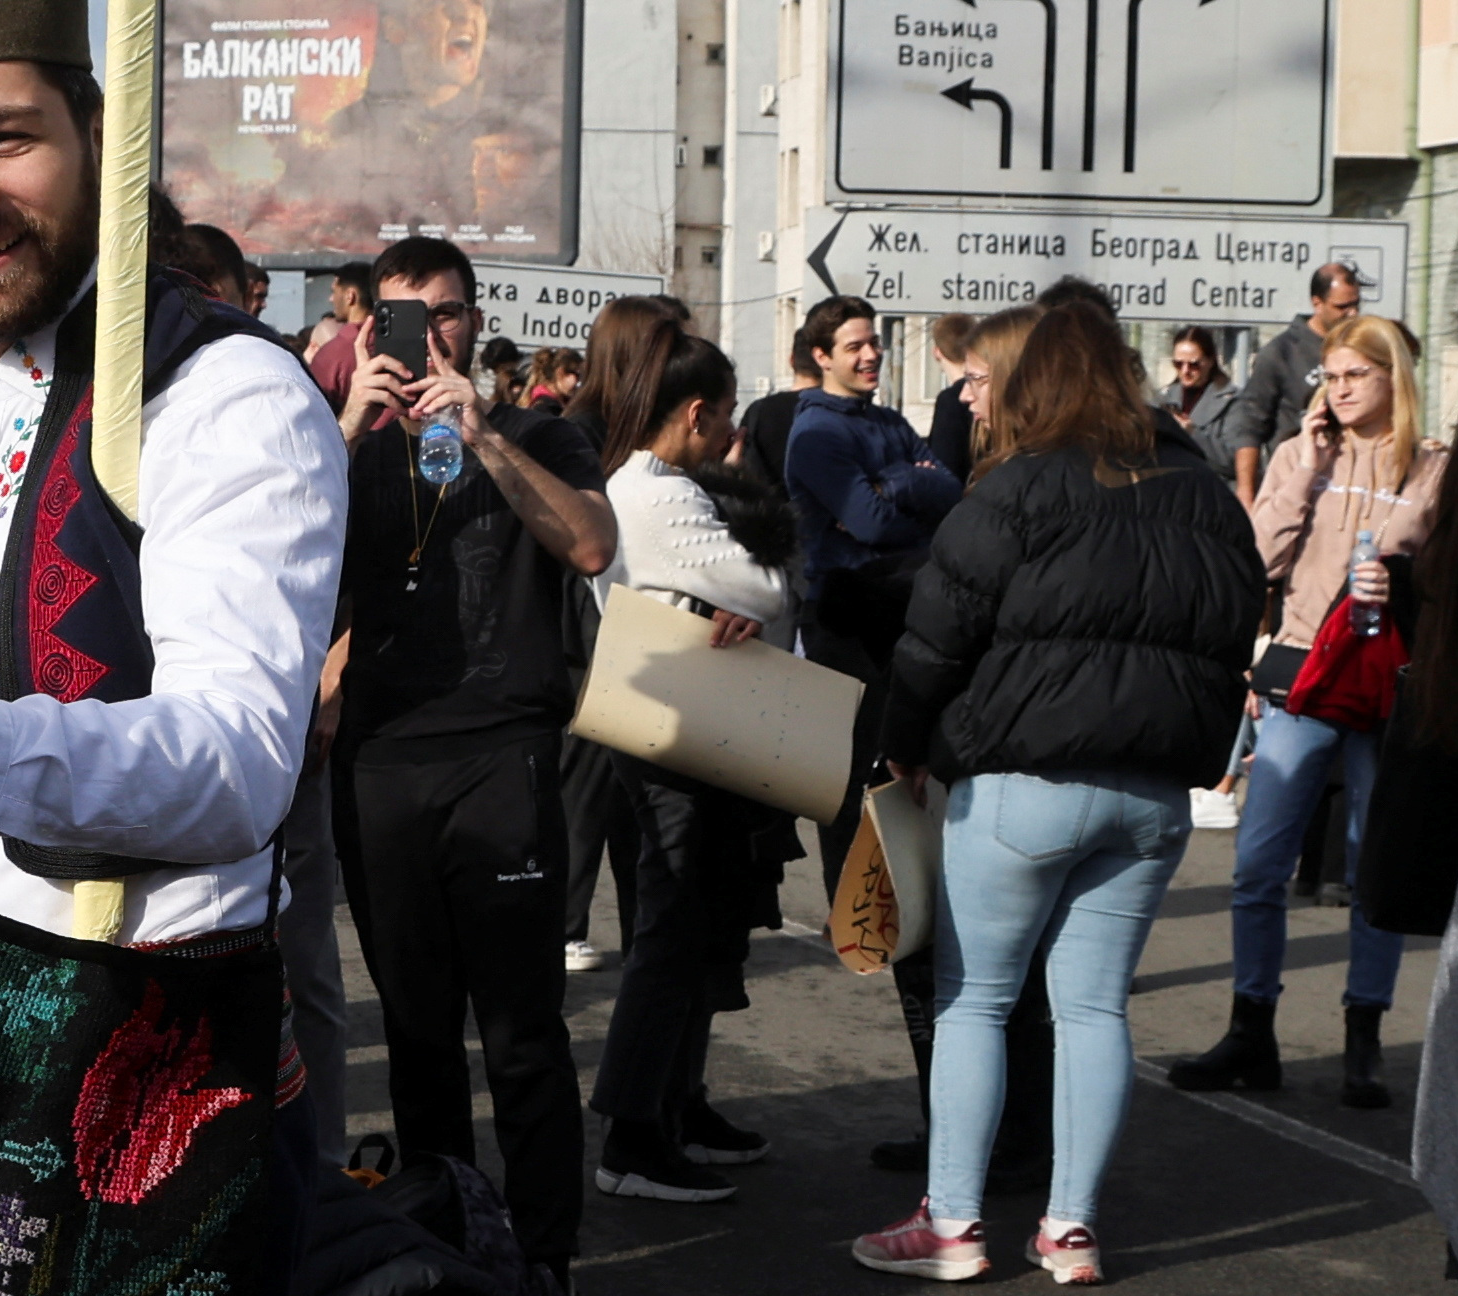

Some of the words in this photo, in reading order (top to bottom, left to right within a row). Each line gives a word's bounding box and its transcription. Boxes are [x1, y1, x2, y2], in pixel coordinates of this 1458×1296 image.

[894, 15, 998, 40] Бањица
[182, 36, 362, 79] БАЛКАНСКИ
[898, 45, 994, 72] Banjica
[242, 82, 296, 123] РАТ
[867, 223, 929, 254] Жел.
[956, 231, 1066, 259] станица
[1090, 229, 1200, 266] Београд
[1215, 233, 1311, 268] Центар
[476, 281, 518, 302] ска
[536, 286, 627, 314] двора
[865, 262, 912, 301] Žel.
[942, 271, 1036, 302] stanica
[1191, 278, 1278, 310] Centar
[522, 312, 592, 340] Indoo
